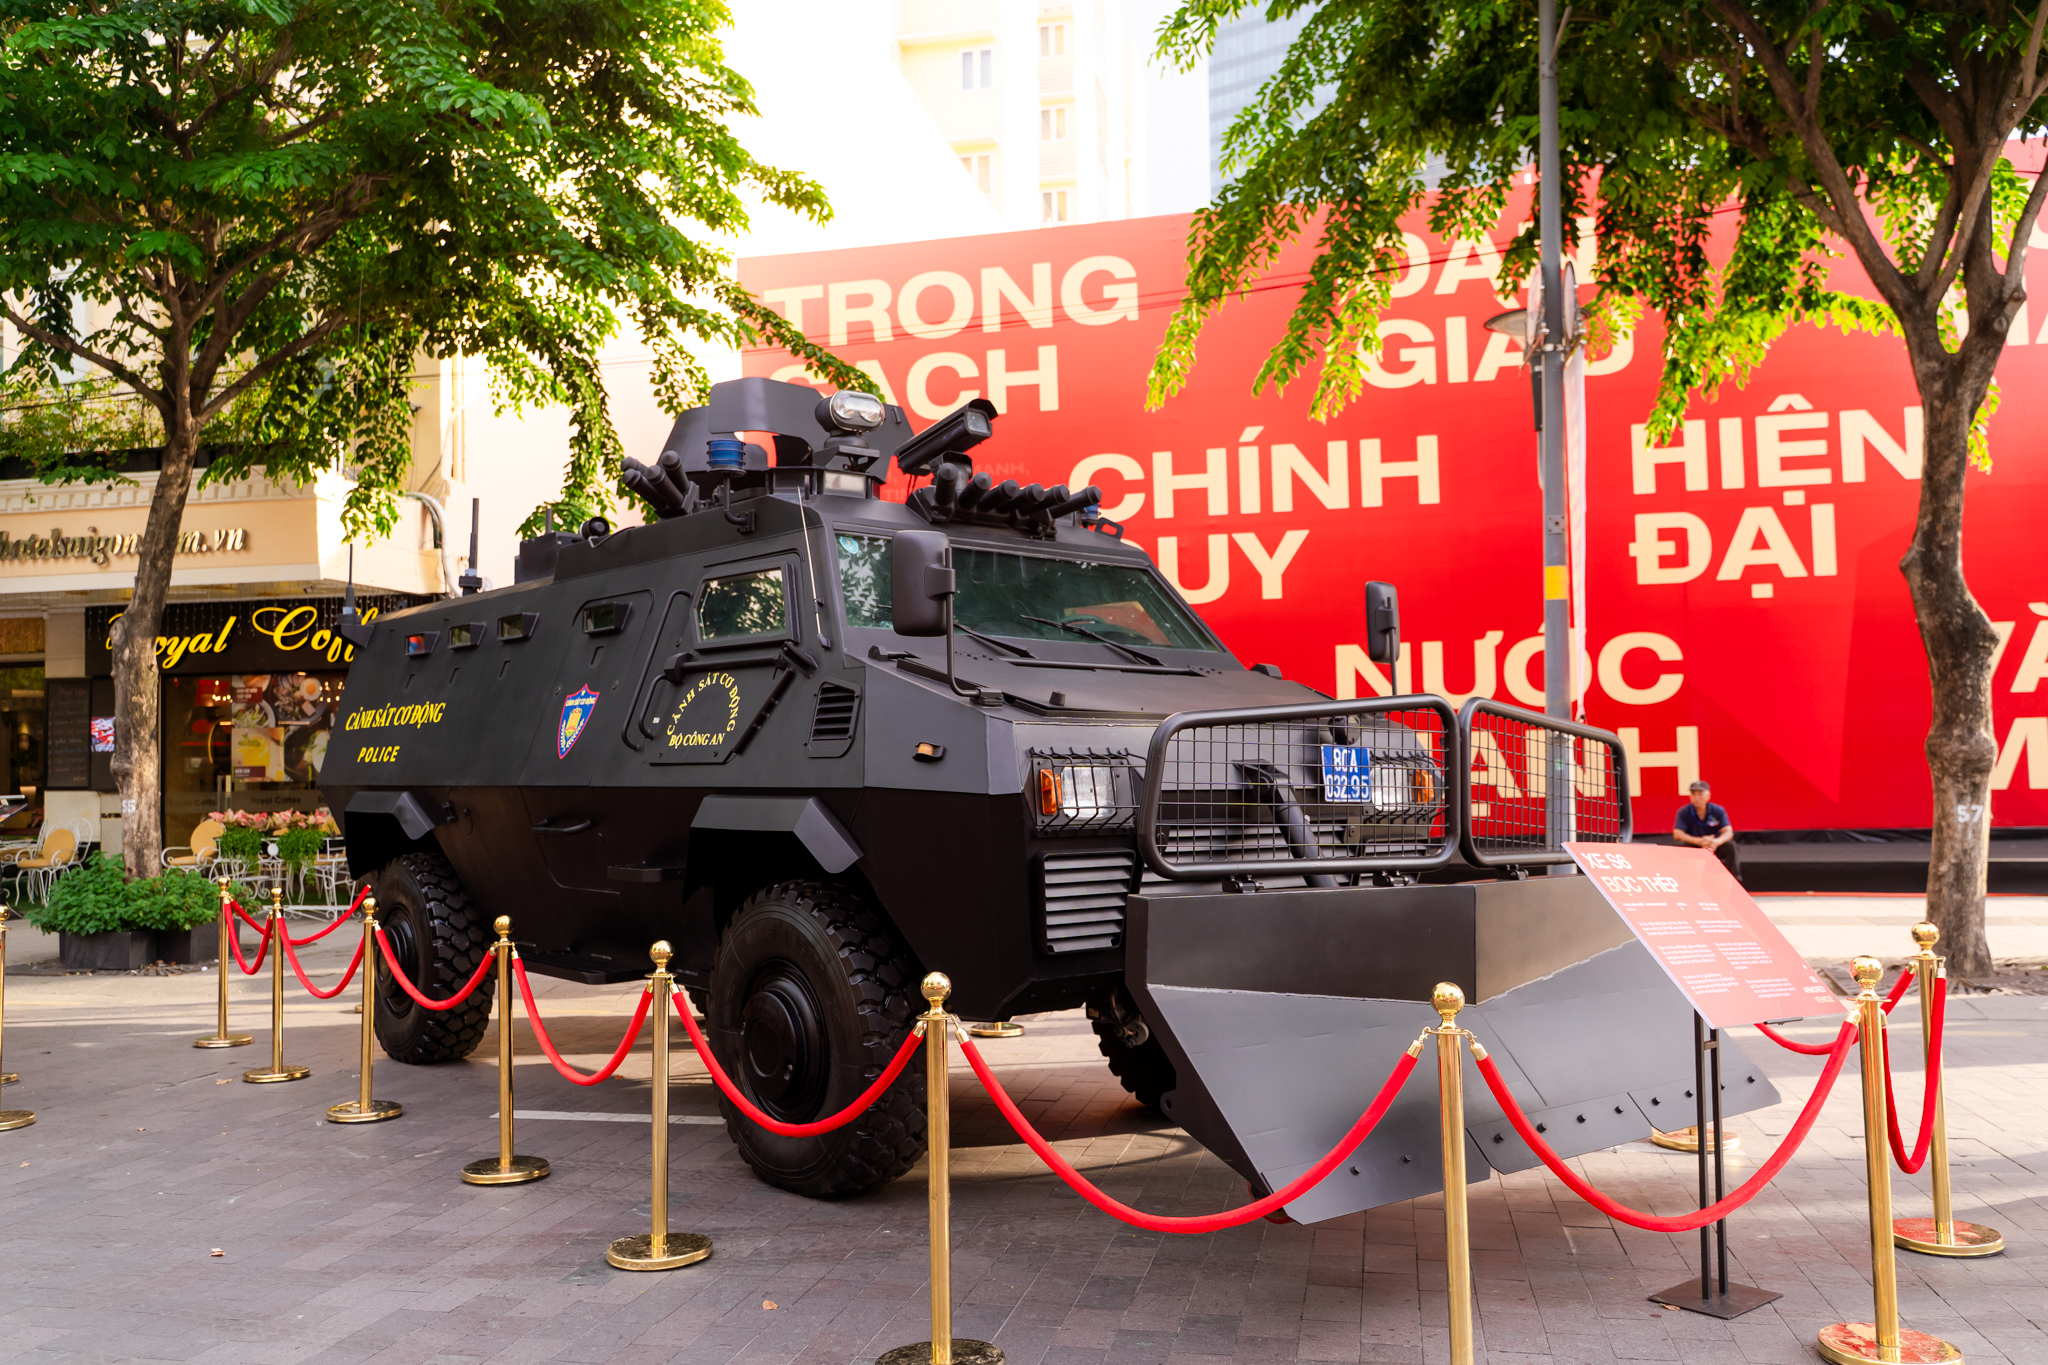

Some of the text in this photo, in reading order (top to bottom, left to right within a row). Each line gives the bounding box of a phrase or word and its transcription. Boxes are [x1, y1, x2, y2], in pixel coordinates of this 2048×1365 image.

[763, 255, 1139, 350] TRONG
[1631, 394, 1925, 506] HIỆN
[1068, 425, 1440, 522] CHÍNH
[1121, 529, 1310, 605] UY
[1629, 503, 1838, 599] ĐẠI
[106, 613, 237, 669] oyal
[1335, 622, 1685, 708] NƯỚC
[372, 703, 397, 728] SÁT
[394, 704, 415, 726] CƠ
[357, 746, 400, 763] POLICE
[683, 730, 711, 746] CÔNG
[709, 732, 725, 746] AN
[1333, 748, 1358, 773] 80A
[1956, 804, 1984, 823] 57
[1580, 853, 1632, 869] XE S6
[1600, 873, 1679, 897] BỌC THÉP
